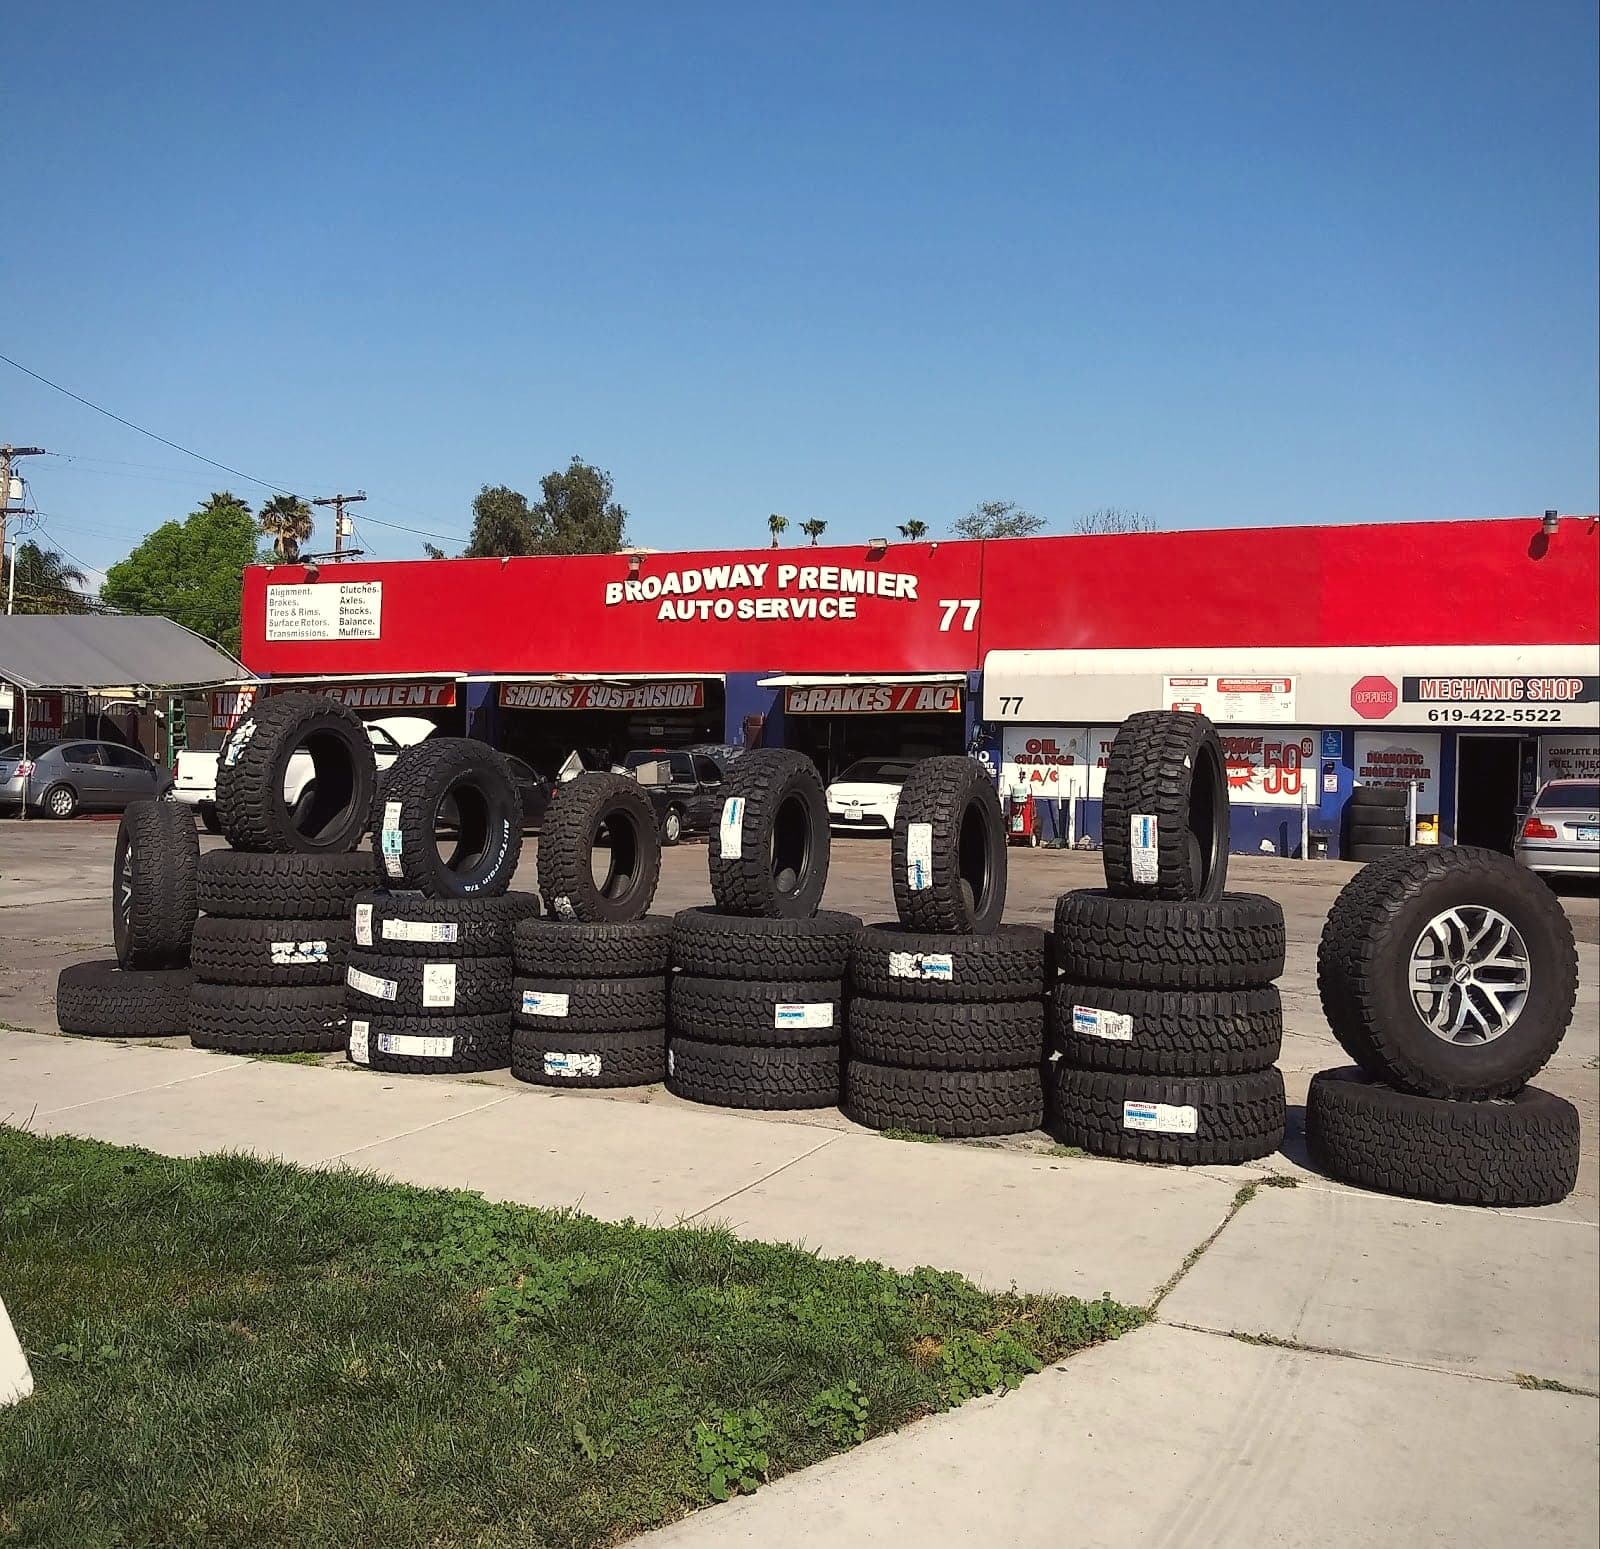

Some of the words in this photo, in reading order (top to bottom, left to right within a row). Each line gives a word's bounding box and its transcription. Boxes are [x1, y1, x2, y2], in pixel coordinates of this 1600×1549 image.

[340, 585, 379, 594] Clutches.
[605, 563, 769, 605] BROADWAY
[777, 564, 918, 600] PREMIER
[270, 588, 313, 597] Alignment.
[269, 598, 300, 607] Brakes.
[269, 608, 289, 617] Tires
[290, 608, 297, 616] &
[298, 608, 321, 616] Rims.
[339, 606, 372, 615] Shocks.
[938, 600, 980, 631] 77
[269, 619, 299, 627] Surface
[301, 618, 330, 627] Rotors.
[339, 617, 375, 626] Balance.
[268, 629, 329, 638] Transmissions.
[338, 627, 376, 637] Mufflers.
[1419, 679, 1524, 700] MECHANIC
[1526, 679, 1583, 700] SHOP
[788, 687, 893, 712] BRAKES
[915, 687, 955, 711] AC
[1355, 691, 1393, 704] OFFICE
[999, 696, 1024, 715] 77
[1428, 709, 1562, 722] 619-422-5522
[1025, 738, 1061, 755] OIL
[1549, 748, 1591, 756] COMPLETE
[1014, 754, 1075, 766] CHANGE
[1366, 752, 1424, 765] DIAGNOSTIC
[1549, 760, 1572, 769] FUEL
[1263, 743, 1302, 794] 59
[1359, 766, 1394, 778] ENGINE
[1396, 767, 1431, 779] REPAIR
[1030, 767, 1058, 786] A/C
